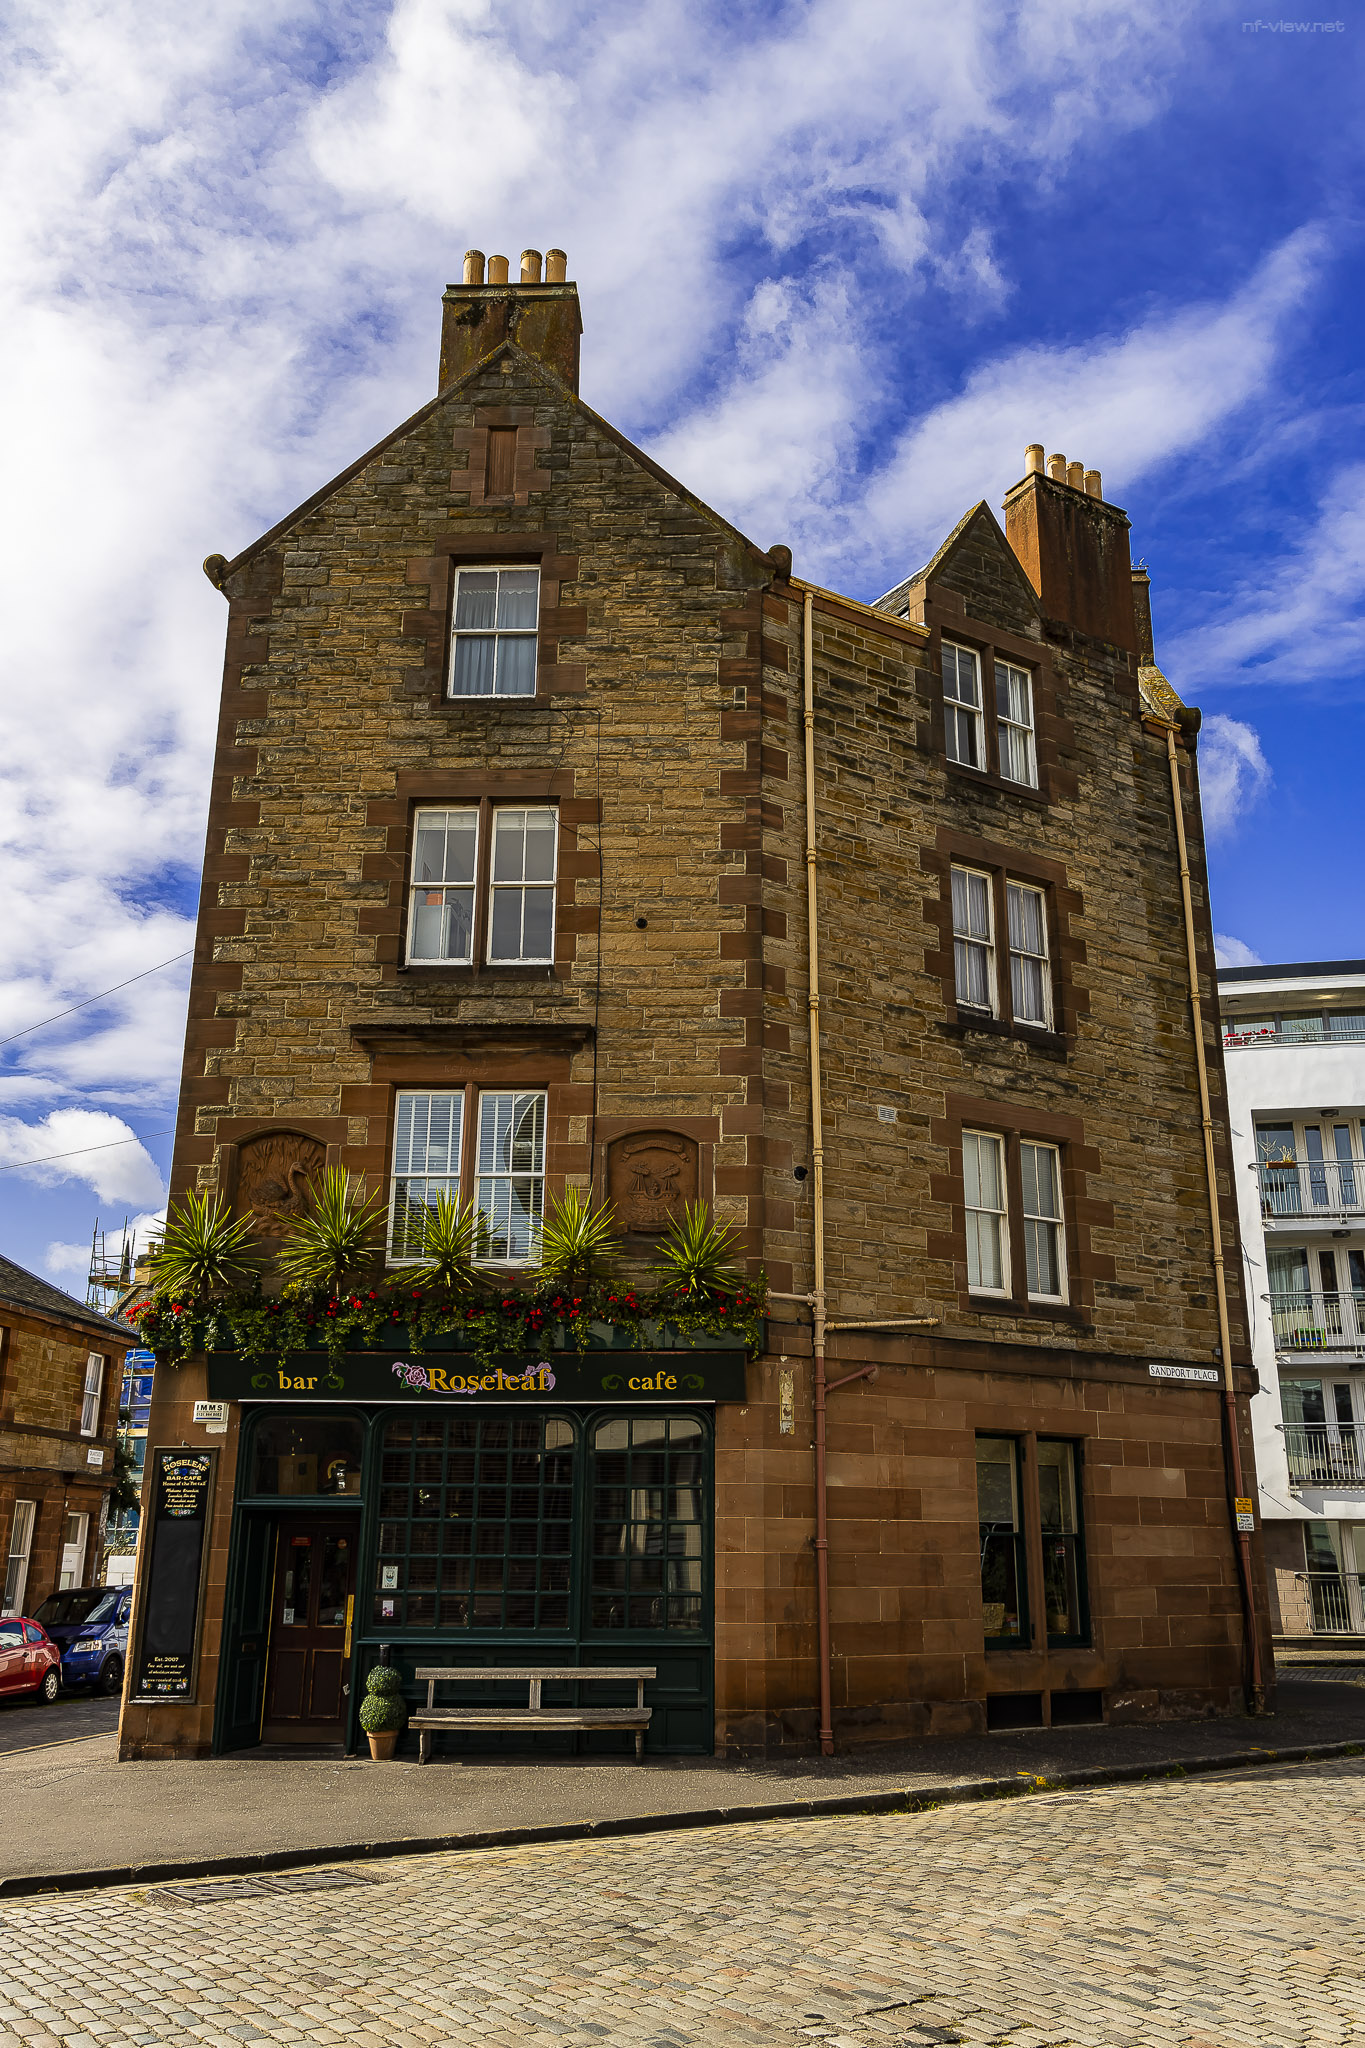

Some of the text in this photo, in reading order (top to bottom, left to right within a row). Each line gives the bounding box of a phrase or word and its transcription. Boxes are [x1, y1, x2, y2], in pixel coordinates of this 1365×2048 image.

[277, 1370, 318, 1390] bar
[427, 1367, 550, 1391] Roseleaf
[1150, 1365, 1218, 1381] SANDPORT PLACE
[196, 1404, 223, 1412] IMMS
[163, 1459, 207, 1472] ROSELEAF
